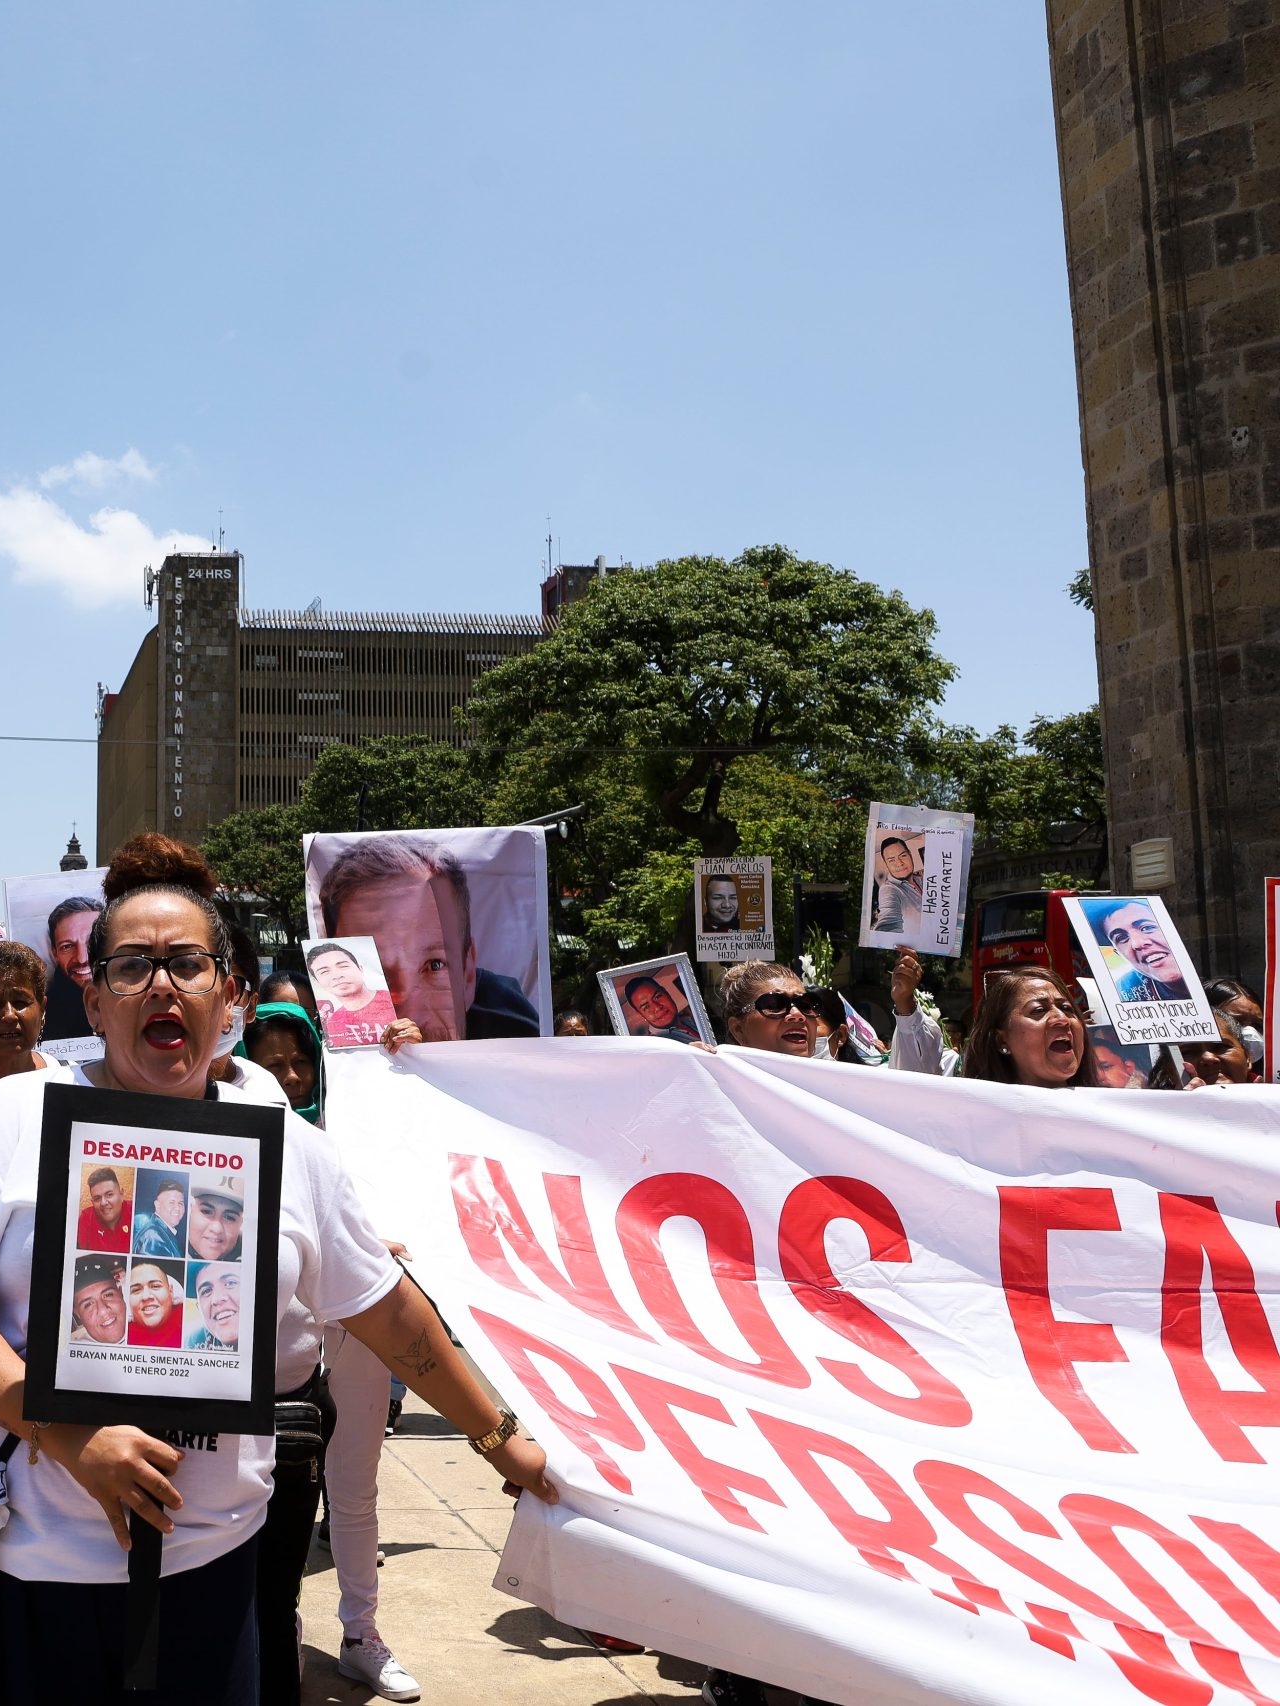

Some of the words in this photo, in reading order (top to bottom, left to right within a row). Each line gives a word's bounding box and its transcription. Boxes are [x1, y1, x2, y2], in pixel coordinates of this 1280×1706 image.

[188, 569, 203, 579] 24
[206, 569, 232, 579] HRS
[174, 577, 184, 818] ESTACIONAMIENTO
[697, 864, 725, 875] JUAN
[730, 863, 765, 874] CARLOS
[923, 875, 938, 914] HASTA
[936, 851, 952, 945] ENCONTRARTE
[1157, 1001, 1199, 1018] Manuel
[1117, 1021, 1171, 1043] Simental
[83, 1139, 244, 1171] DESAPARECIDO
[448, 1152, 973, 1428] NOS
[998, 1185, 1280, 1466] FA
[69, 1350, 108, 1361] BRAYAN
[109, 1352, 148, 1363] MANUEL
[150, 1355, 196, 1366] SIMENTAL
[197, 1358, 240, 1369] SANCHEZ
[122, 1365, 133, 1374] 10
[134, 1366, 168, 1377] ENERO
[169, 1368, 190, 1378] 2022
